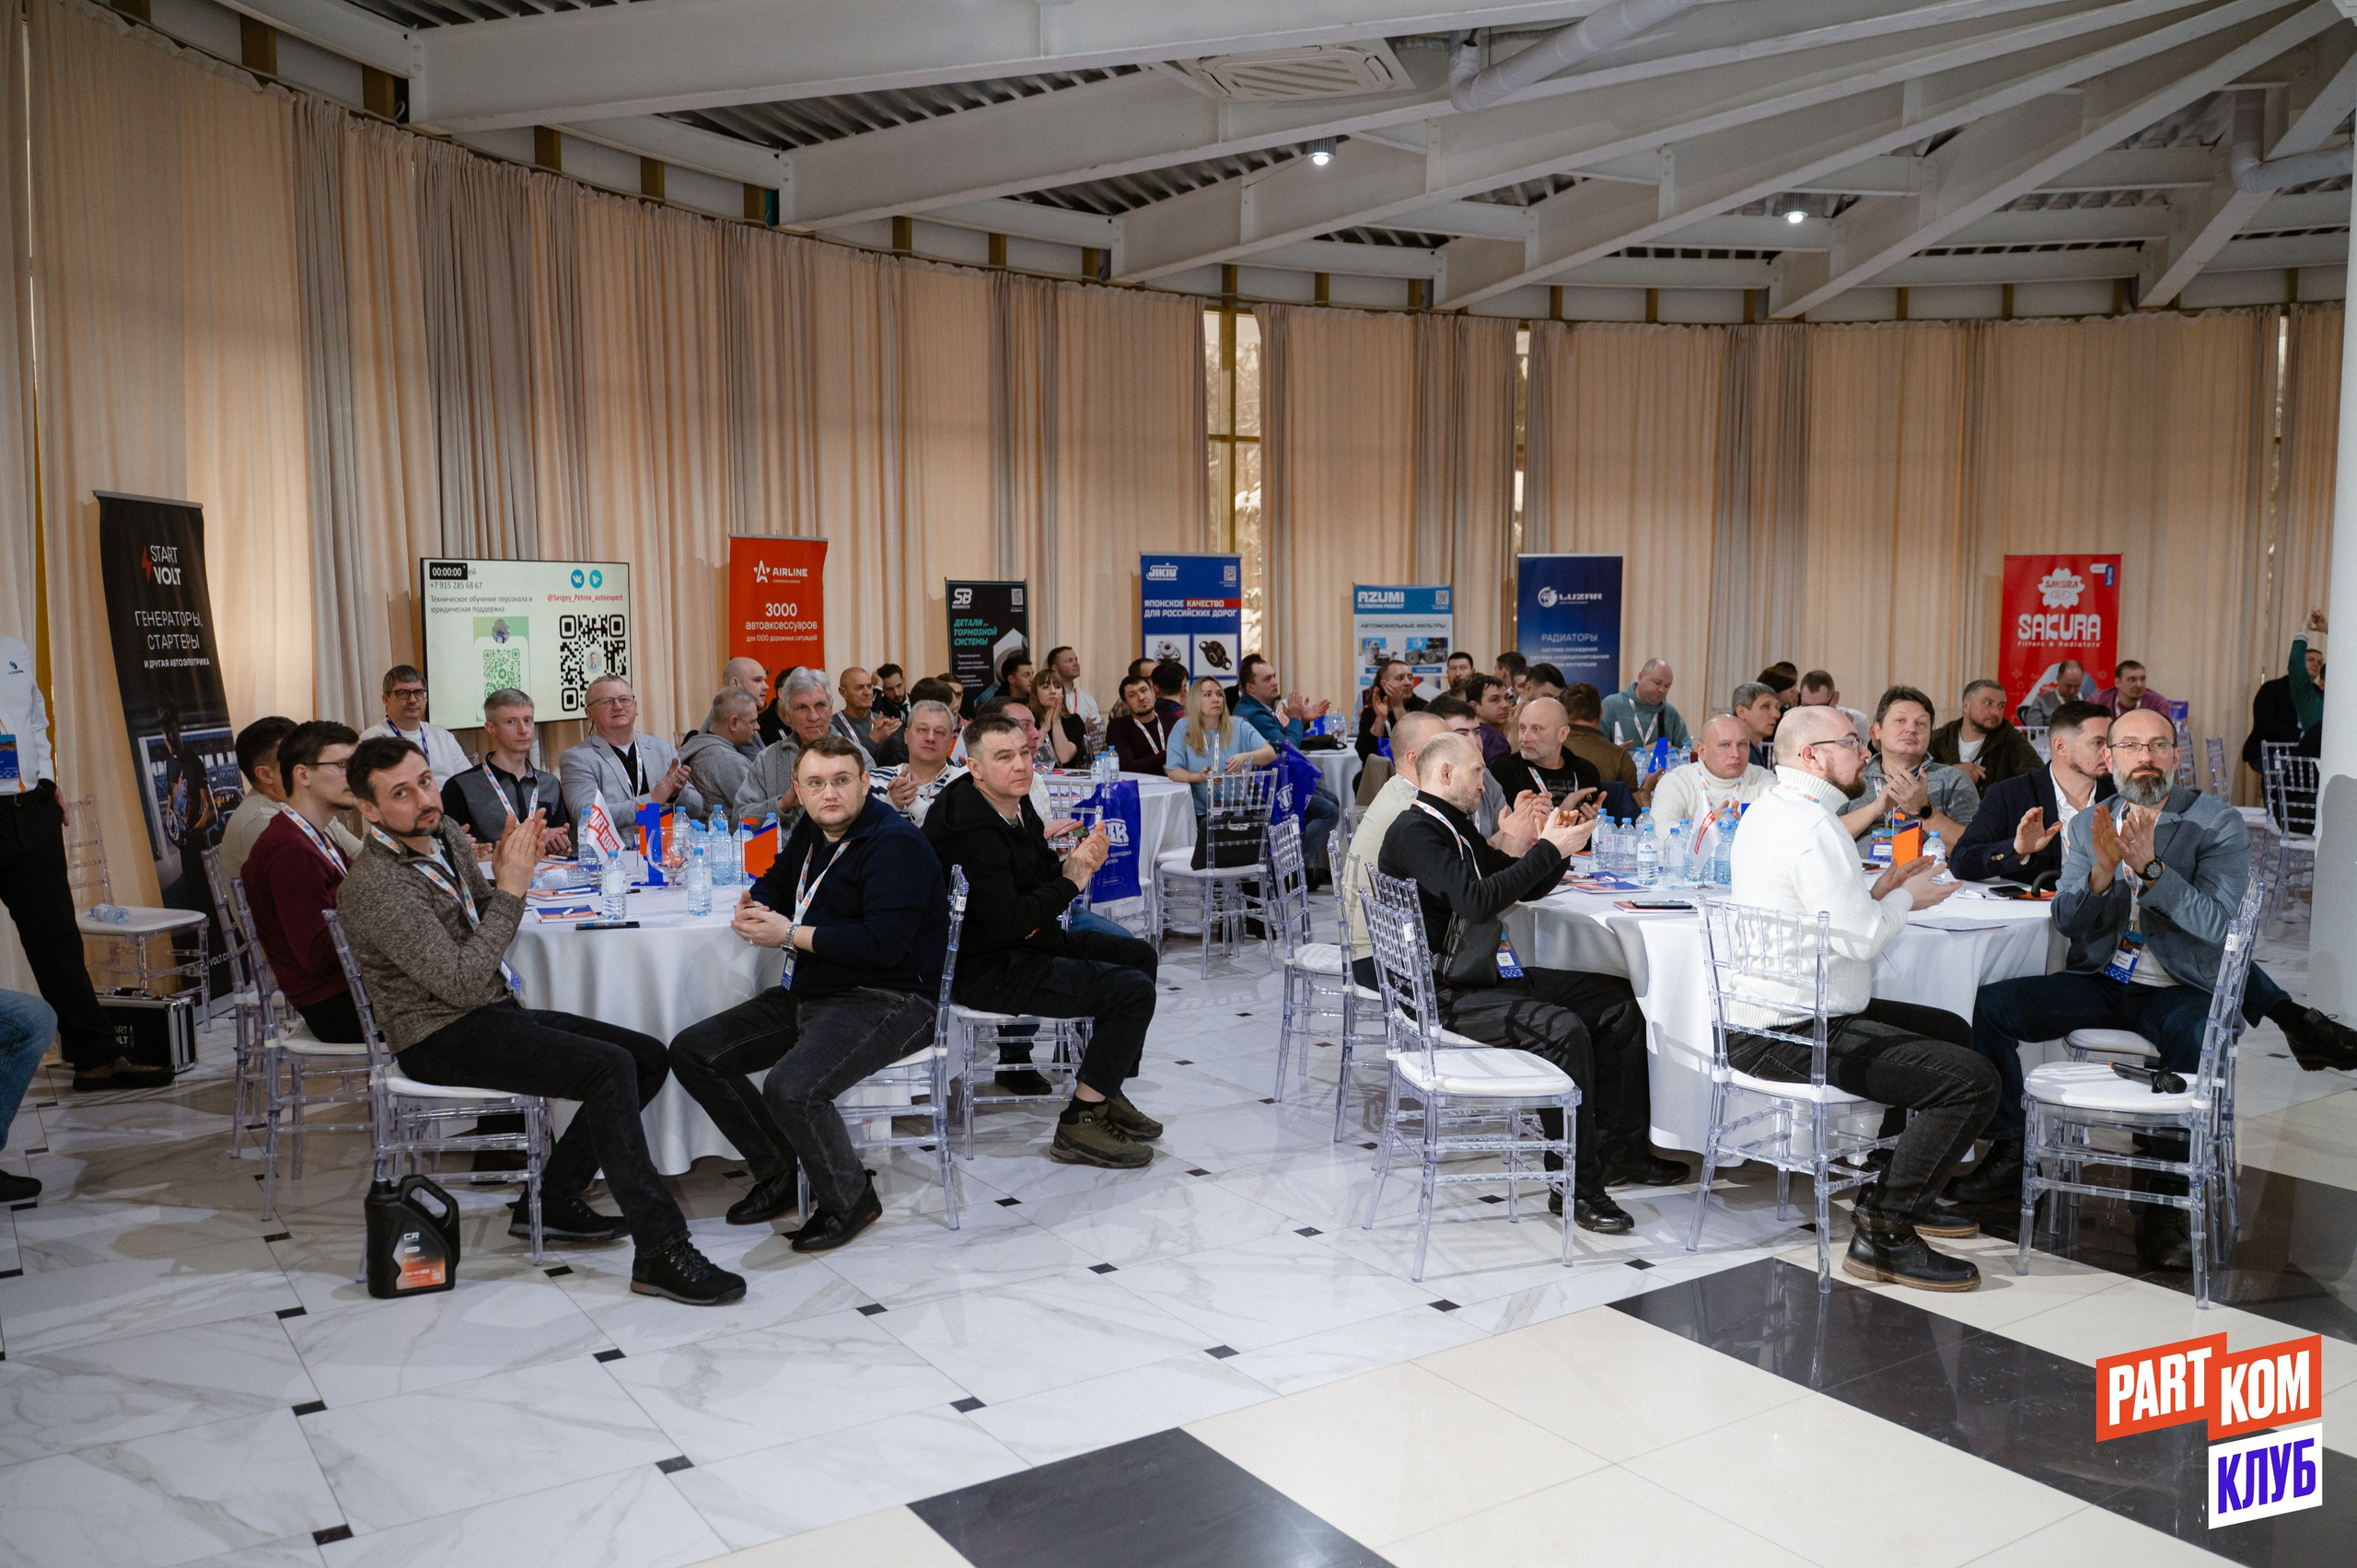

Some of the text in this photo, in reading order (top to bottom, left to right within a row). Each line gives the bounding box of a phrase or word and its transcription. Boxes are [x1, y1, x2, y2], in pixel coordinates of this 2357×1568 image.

[150, 545, 177, 563] START
[153, 567, 181, 585] VOLT
[433, 567, 462, 576] 00:00:00
[772, 567, 808, 577] AIRLINE
[2045, 580, 2078, 589] SAKURA
[1358, 591, 1405, 603] AZUMI
[766, 603, 797, 617] 3000
[1144, 610, 1160, 618] ДЛЯ
[1162, 608, 1210, 617] РОССИЙСКИХ
[135, 611, 203, 627] ГЕНЕРАТОРЫ,
[746, 621, 817, 631] автоаксессуаров
[2018, 614, 2101, 641] SAKURA
[954, 627, 997, 636] ТОРМОЗНОЙ
[147, 634, 200, 650] СТАРТЕРЫ
[1542, 633, 1598, 642] РАДИАТОРЫ
[150, 659, 169, 668] ДРУГАЯ
